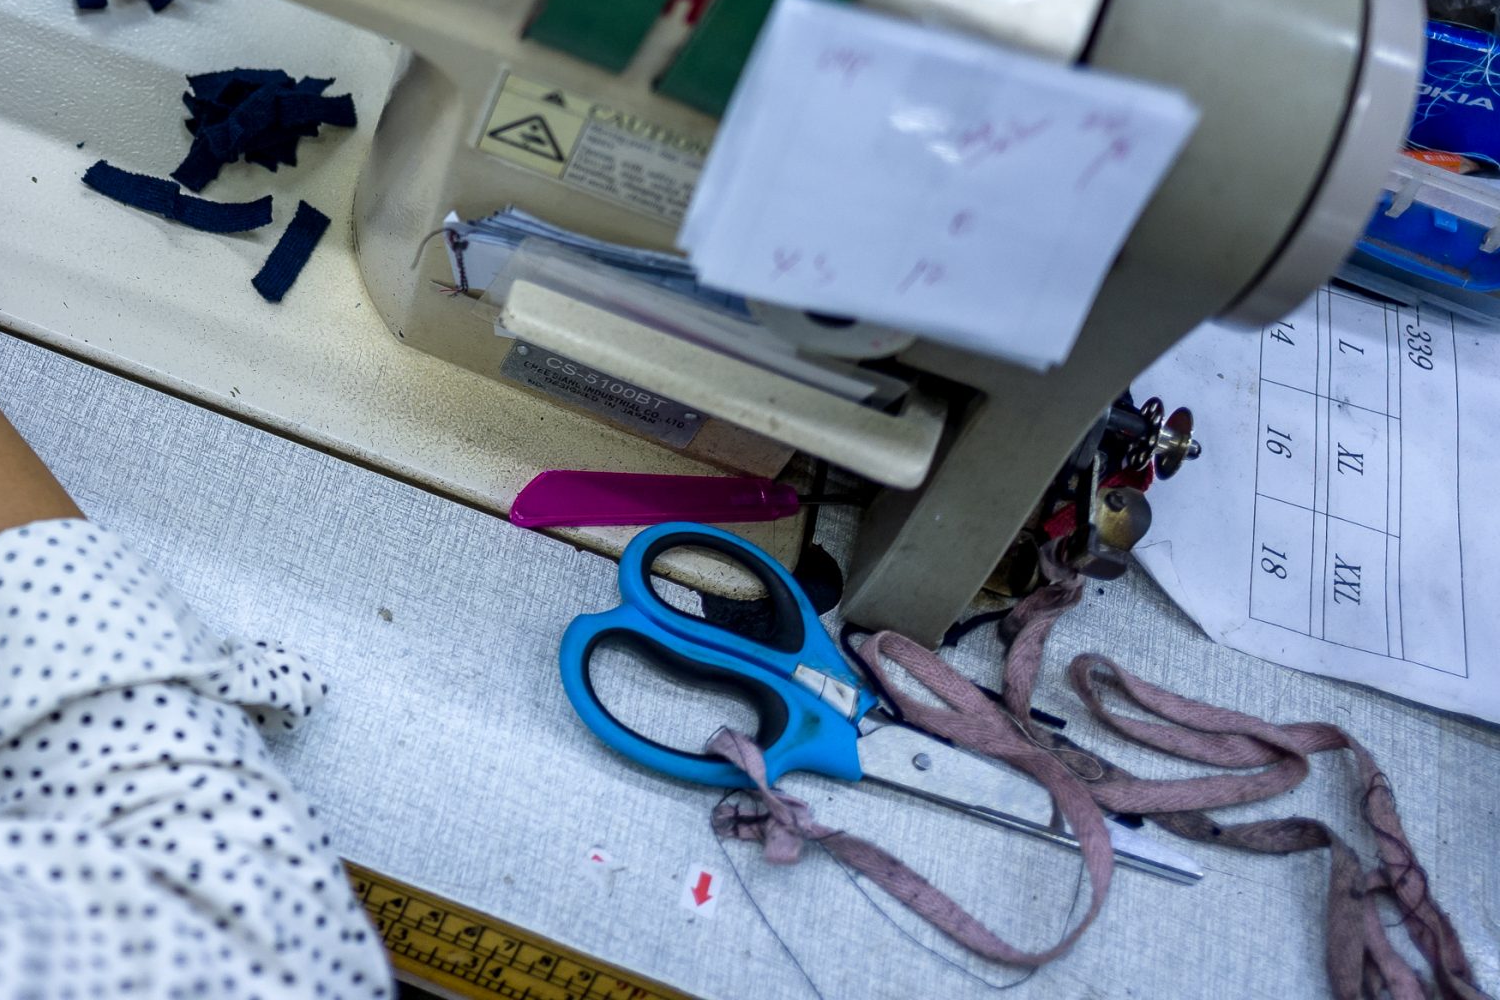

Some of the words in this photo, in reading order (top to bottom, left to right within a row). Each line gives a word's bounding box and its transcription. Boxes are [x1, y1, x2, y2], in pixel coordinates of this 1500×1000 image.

[1414, 82, 1493, 111] OKIA
[1270, 320, 1295, 346] 14
[1338, 338, 1365, 355] L
[546, 357, 667, 408] CS-5100BT
[584, 384, 642, 411] INDUSTRIAL
[1266, 424, 1292, 459] 16
[1337, 442, 1364, 476] XL
[1261, 542, 1287, 580] 18
[1333, 553, 1361, 605] XXL
